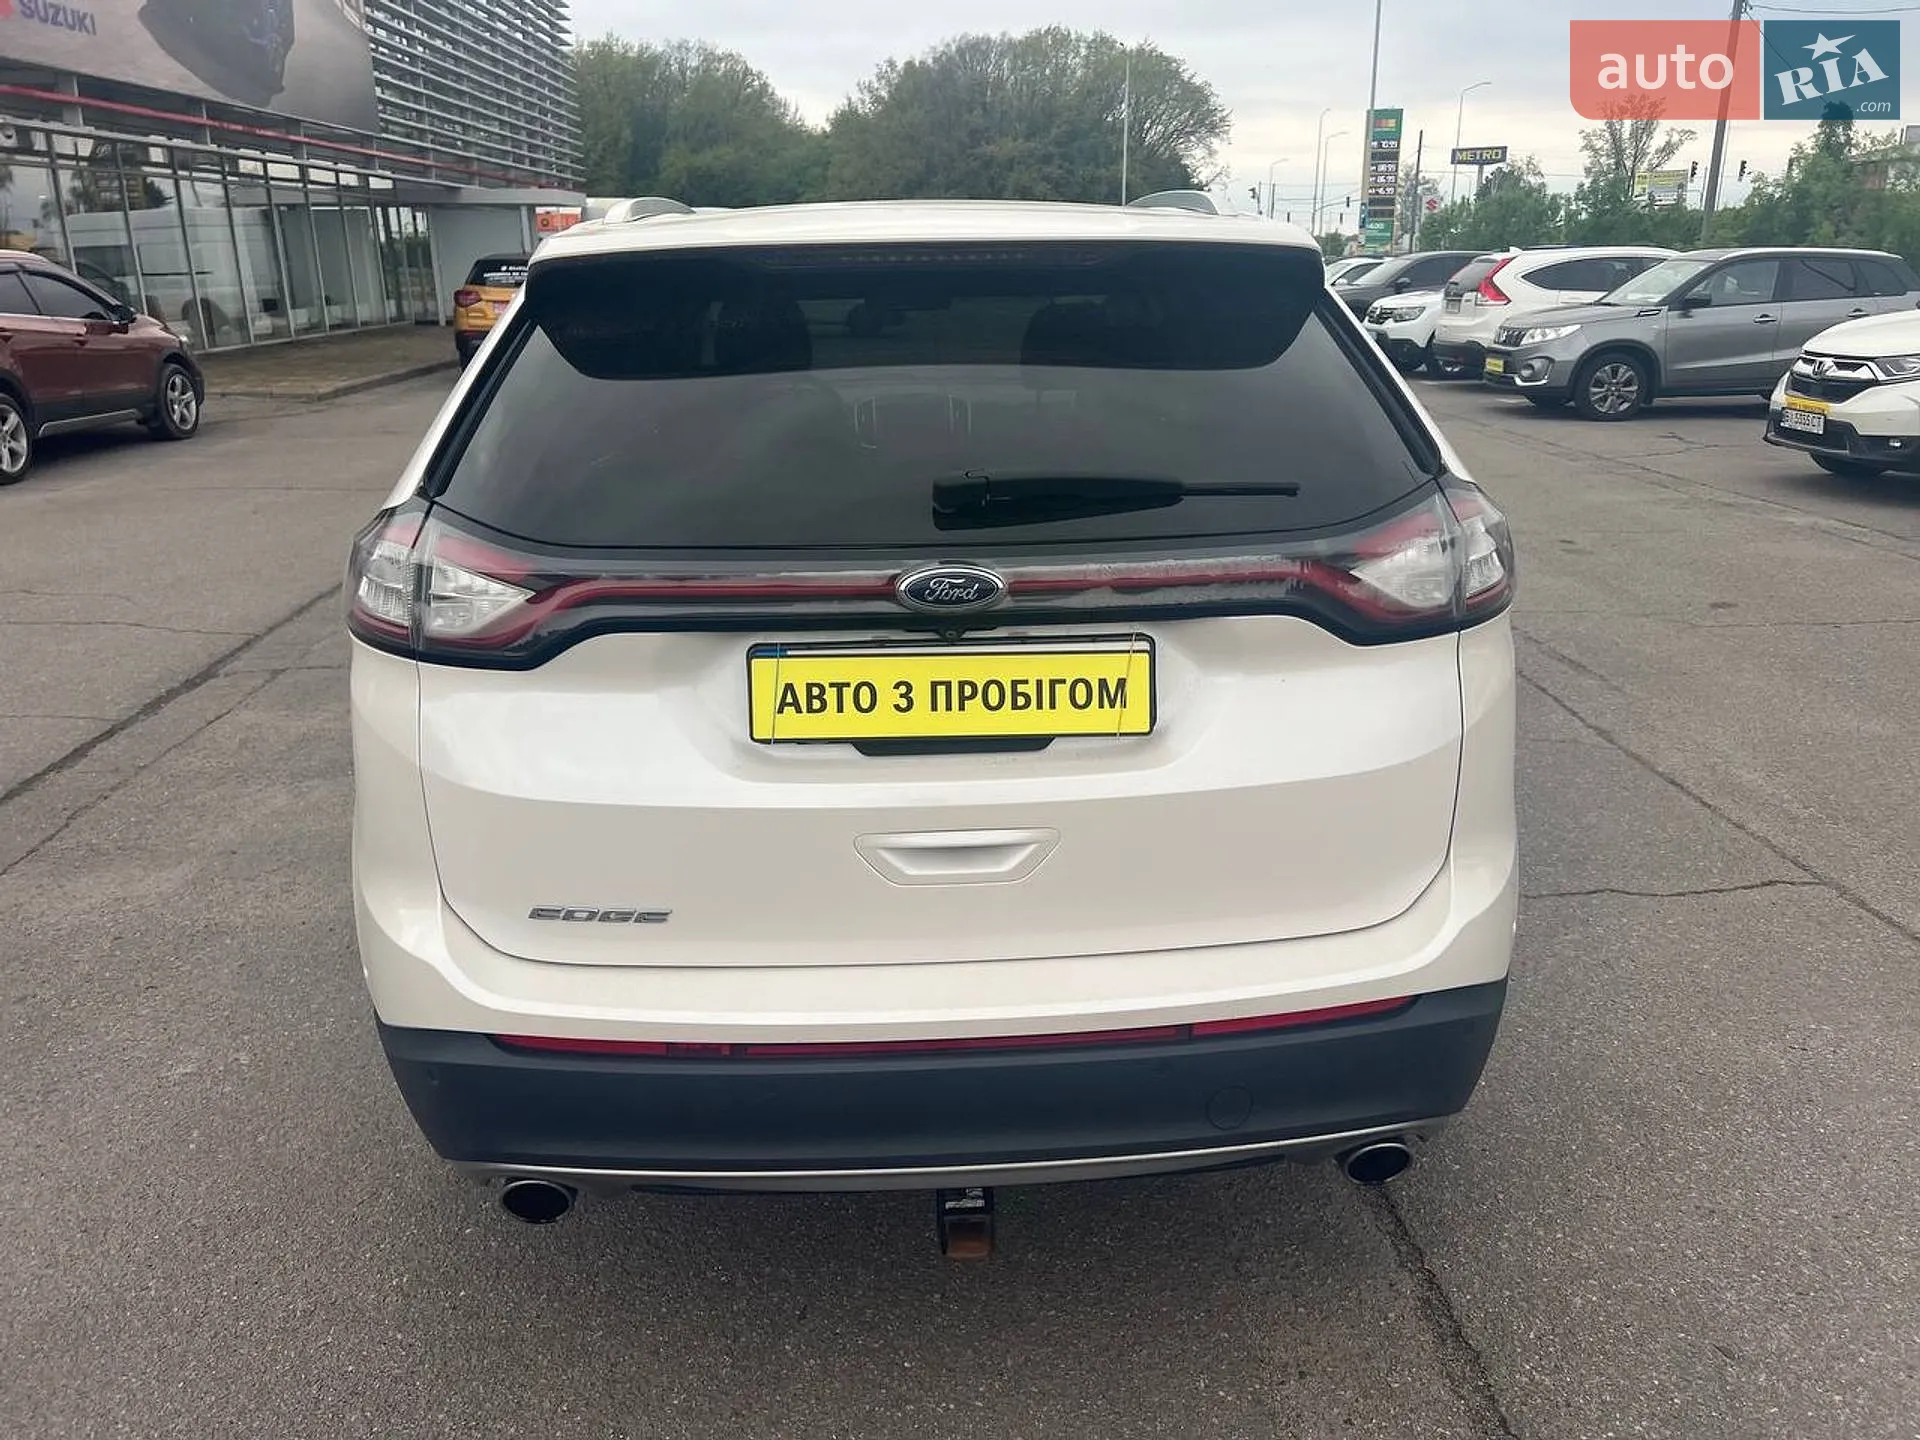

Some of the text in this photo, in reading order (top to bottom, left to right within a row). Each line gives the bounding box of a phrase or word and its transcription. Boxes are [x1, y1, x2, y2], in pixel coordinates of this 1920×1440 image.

[19, 0, 97, 36] SUZUKI
[1455, 149, 1502, 161] METRO
[924, 577, 979, 600] Ford
[777, 681, 877, 715] АВТО
[929, 677, 1127, 713] ПРОБІГОМ
[528, 905, 672, 923] EDGE
